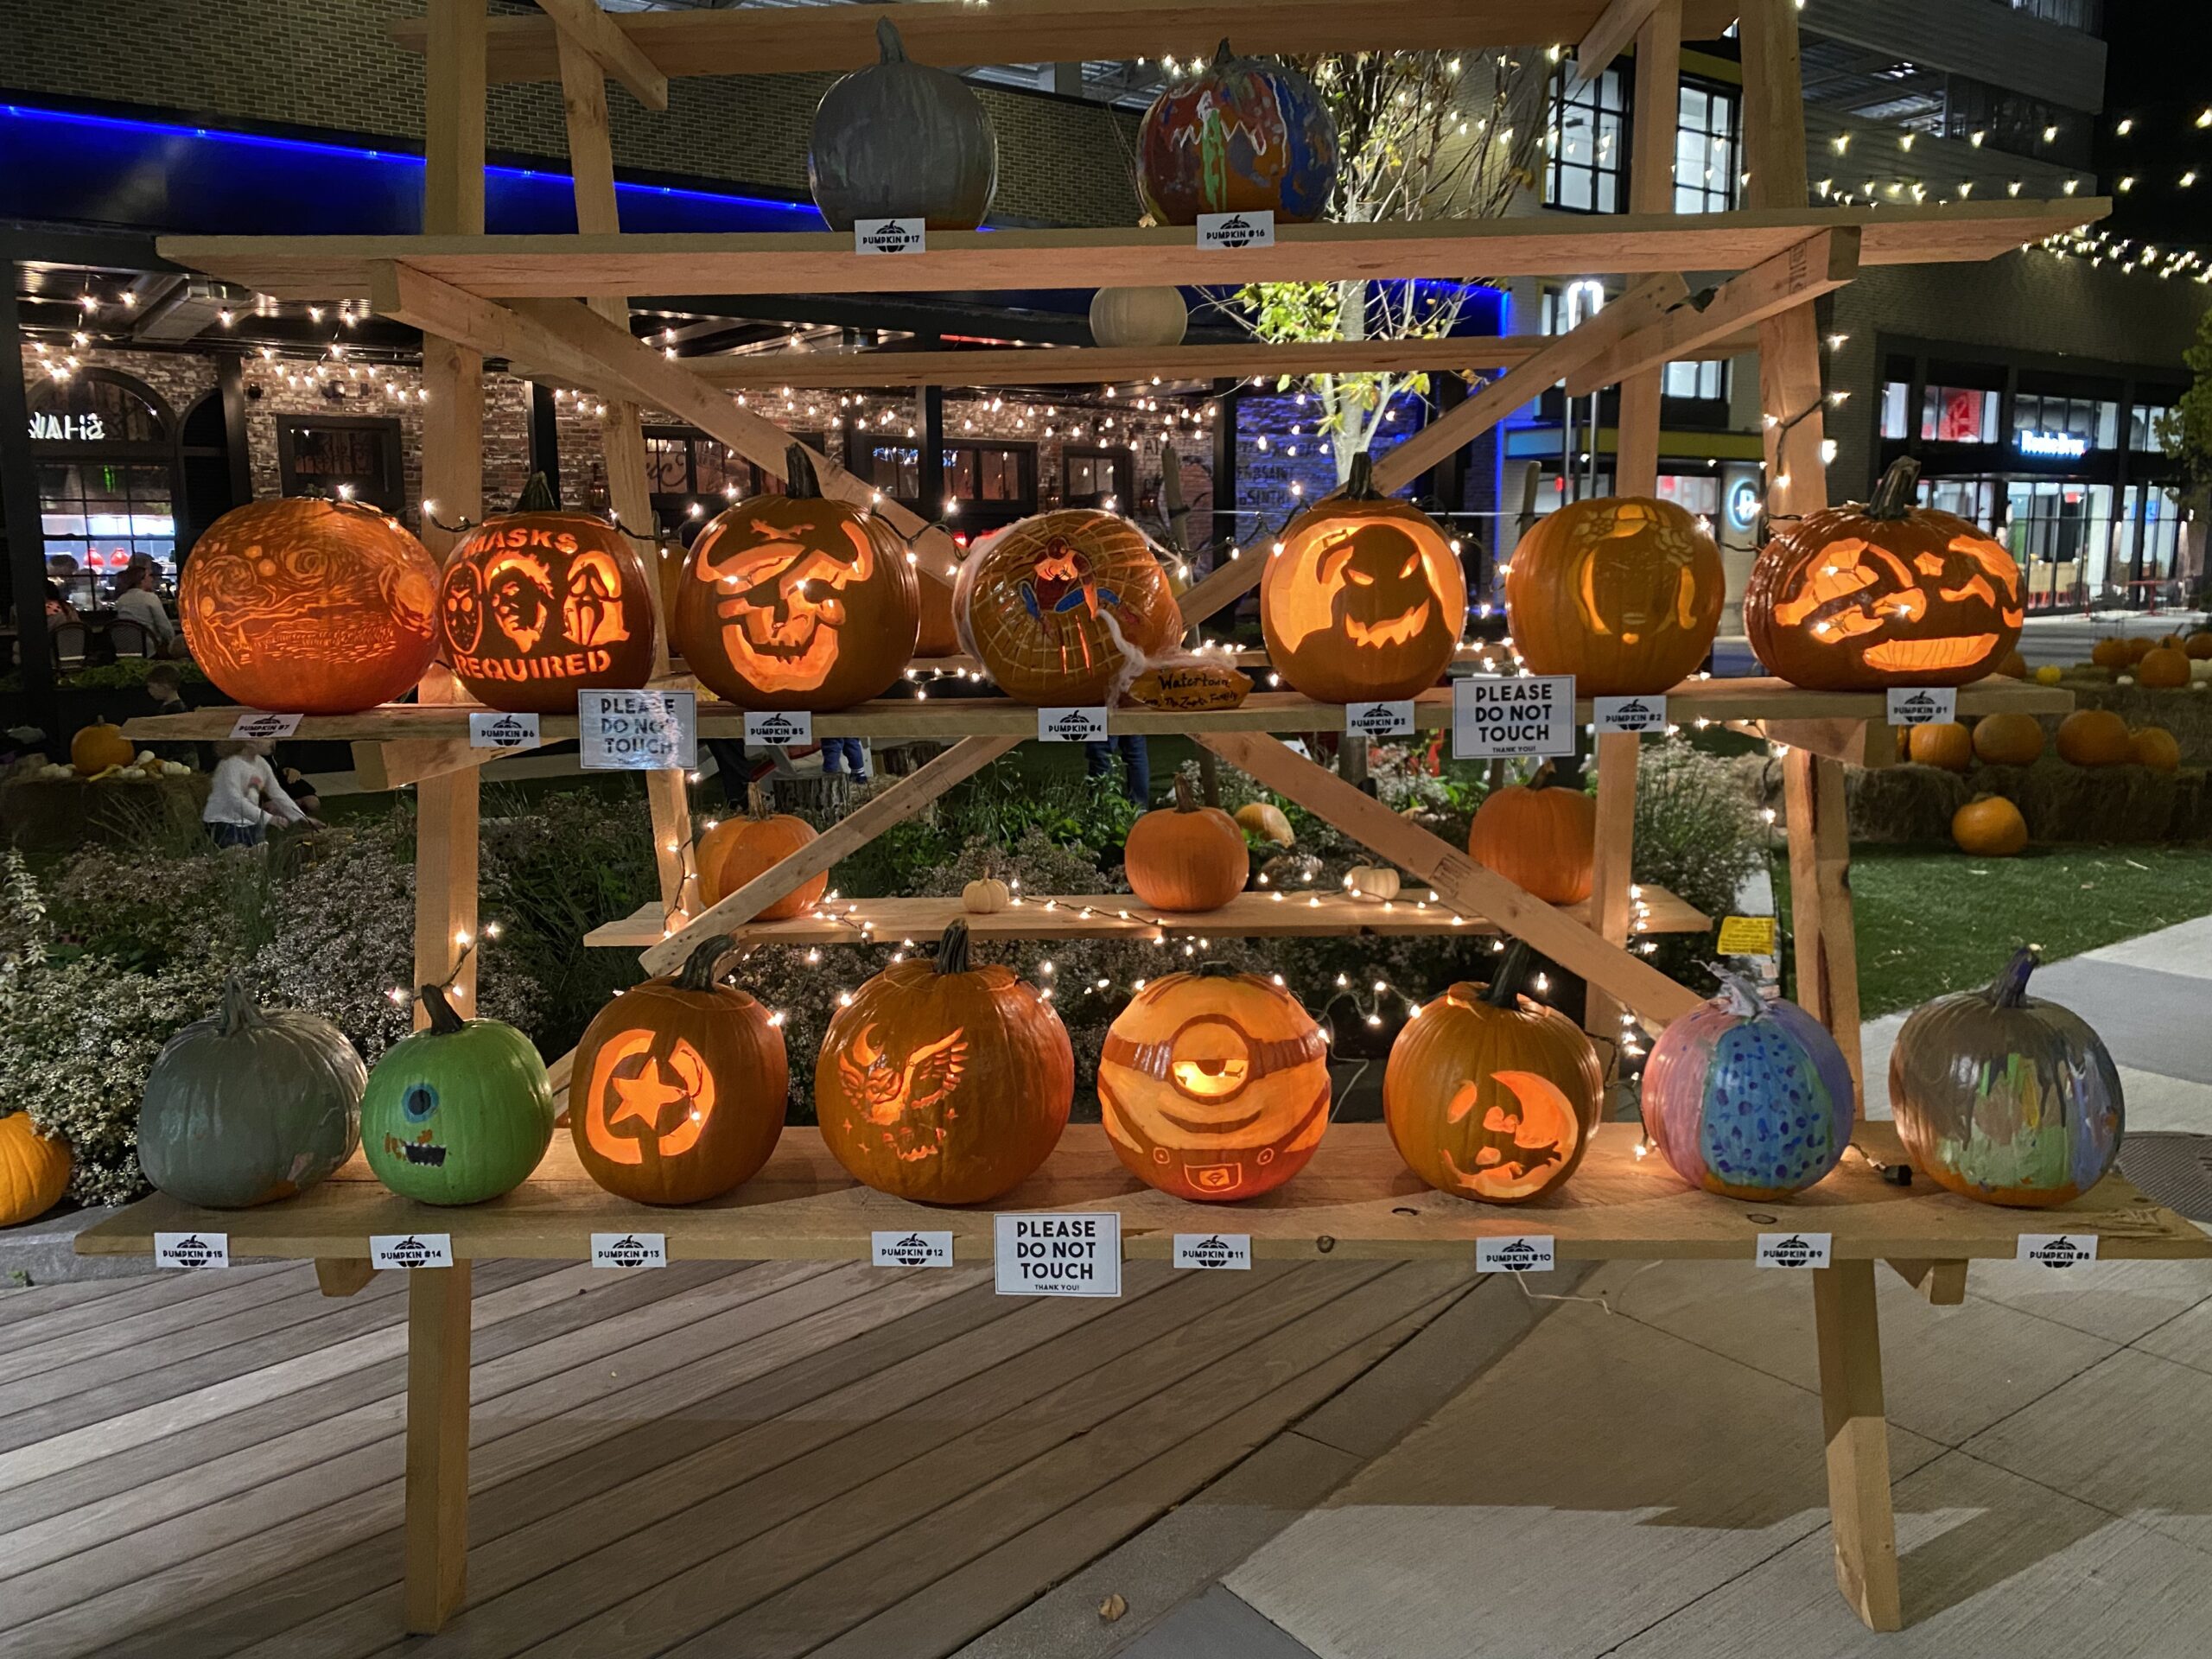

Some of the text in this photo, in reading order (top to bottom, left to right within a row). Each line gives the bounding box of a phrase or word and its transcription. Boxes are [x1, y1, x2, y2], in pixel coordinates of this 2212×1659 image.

[862, 235, 902, 244] PUMPKIN
[1249, 229, 1265, 238] #16
[462, 528, 578, 559] MASKS
[454, 650, 611, 683] REQUIRED
[1476, 683, 1552, 702] PLEASE
[601, 698, 676, 715] PLEAE
[1475, 704, 1552, 722] DO NOT
[601, 718, 678, 734] DO NO
[1351, 719, 1391, 728] PUMPKIN
[1478, 725, 1549, 742] TOUCH
[605, 738, 673, 754] TOUCH
[1017, 1220, 1096, 1237] PLEASE
[1017, 1242, 1096, 1258] DO NOT
[2030, 1251, 2073, 1260] PUMPKIN
[1020, 1262, 1093, 1280] TOUCH
